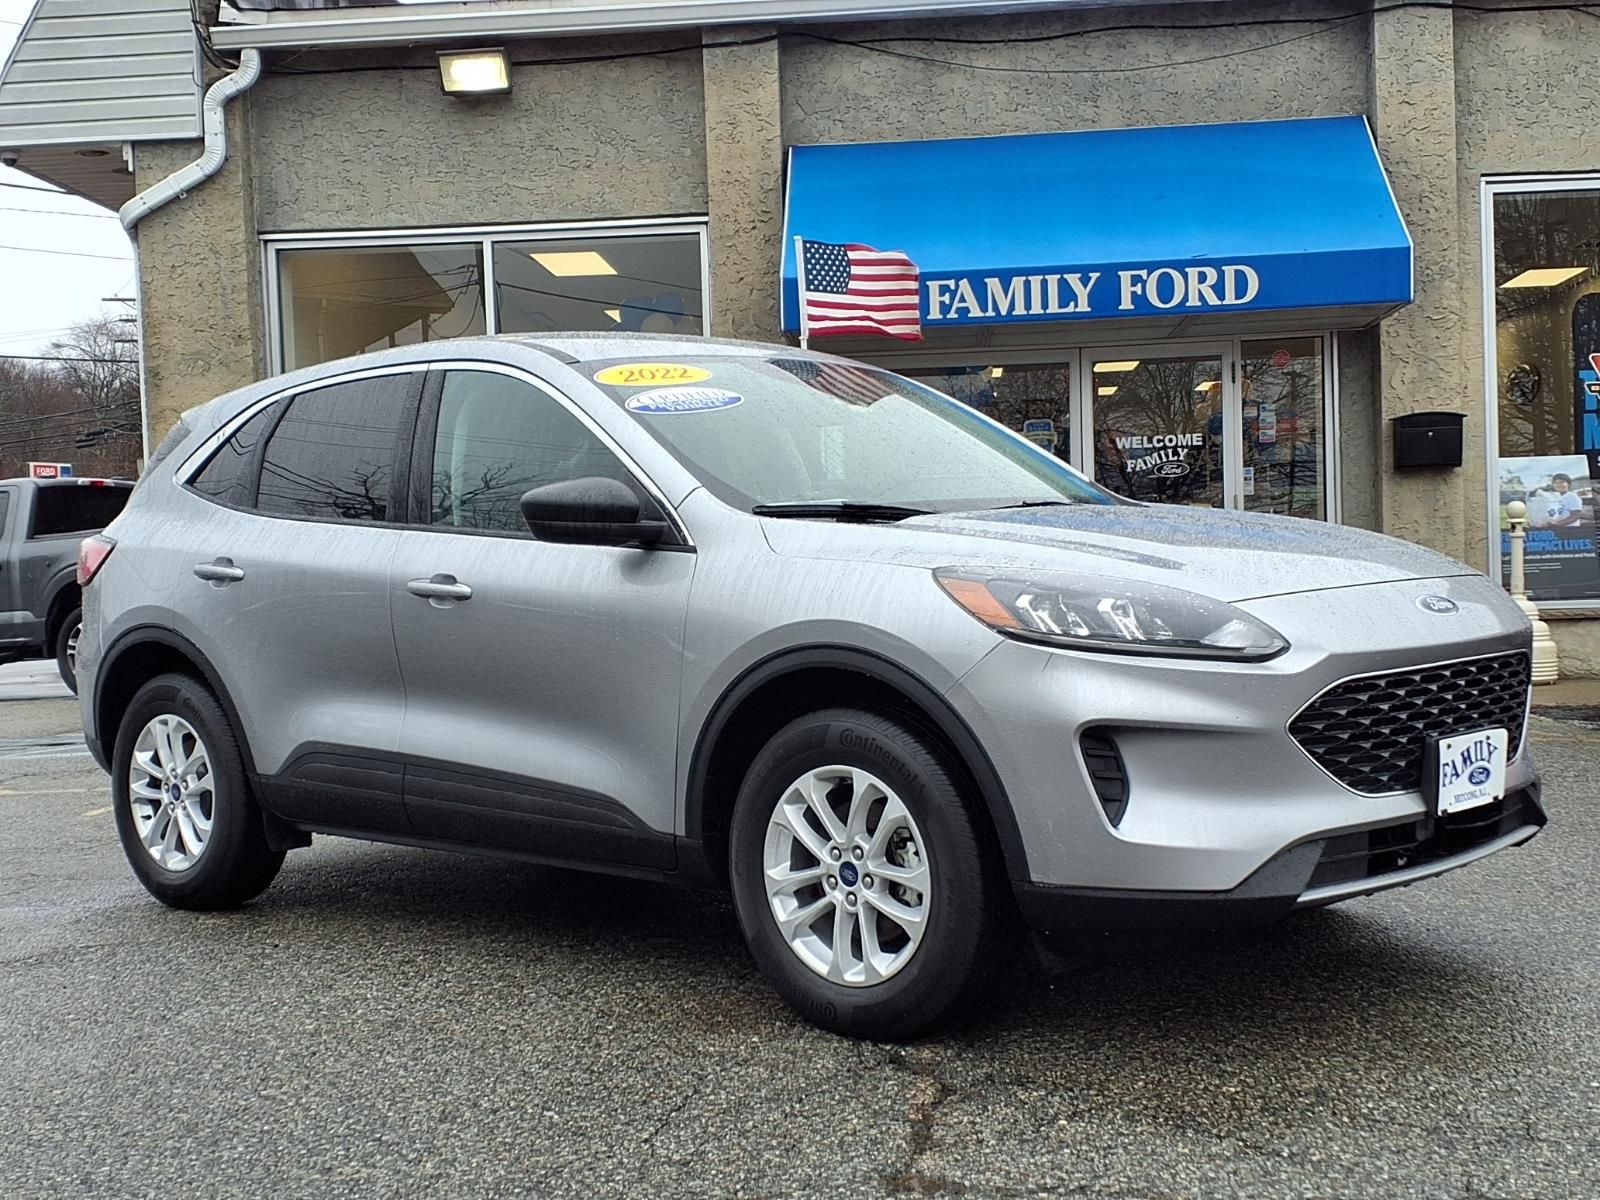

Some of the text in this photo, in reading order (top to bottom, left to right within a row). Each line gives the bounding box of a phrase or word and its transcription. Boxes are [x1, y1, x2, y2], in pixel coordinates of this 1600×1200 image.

[925, 264, 1260, 320] FAMILY FORD
[619, 367, 693, 383] 2022
[1115, 433, 1204, 450] WELCOME
[1126, 447, 1190, 473] FAMILY
[35, 466, 56, 477] FORD
[1160, 464, 1183, 475] Ford
[1564, 539, 1596, 551] LIVES.
[1426, 597, 1456, 610] Ford
[840, 728, 919, 785] Continental
[1441, 740, 1499, 788] FAMILY
